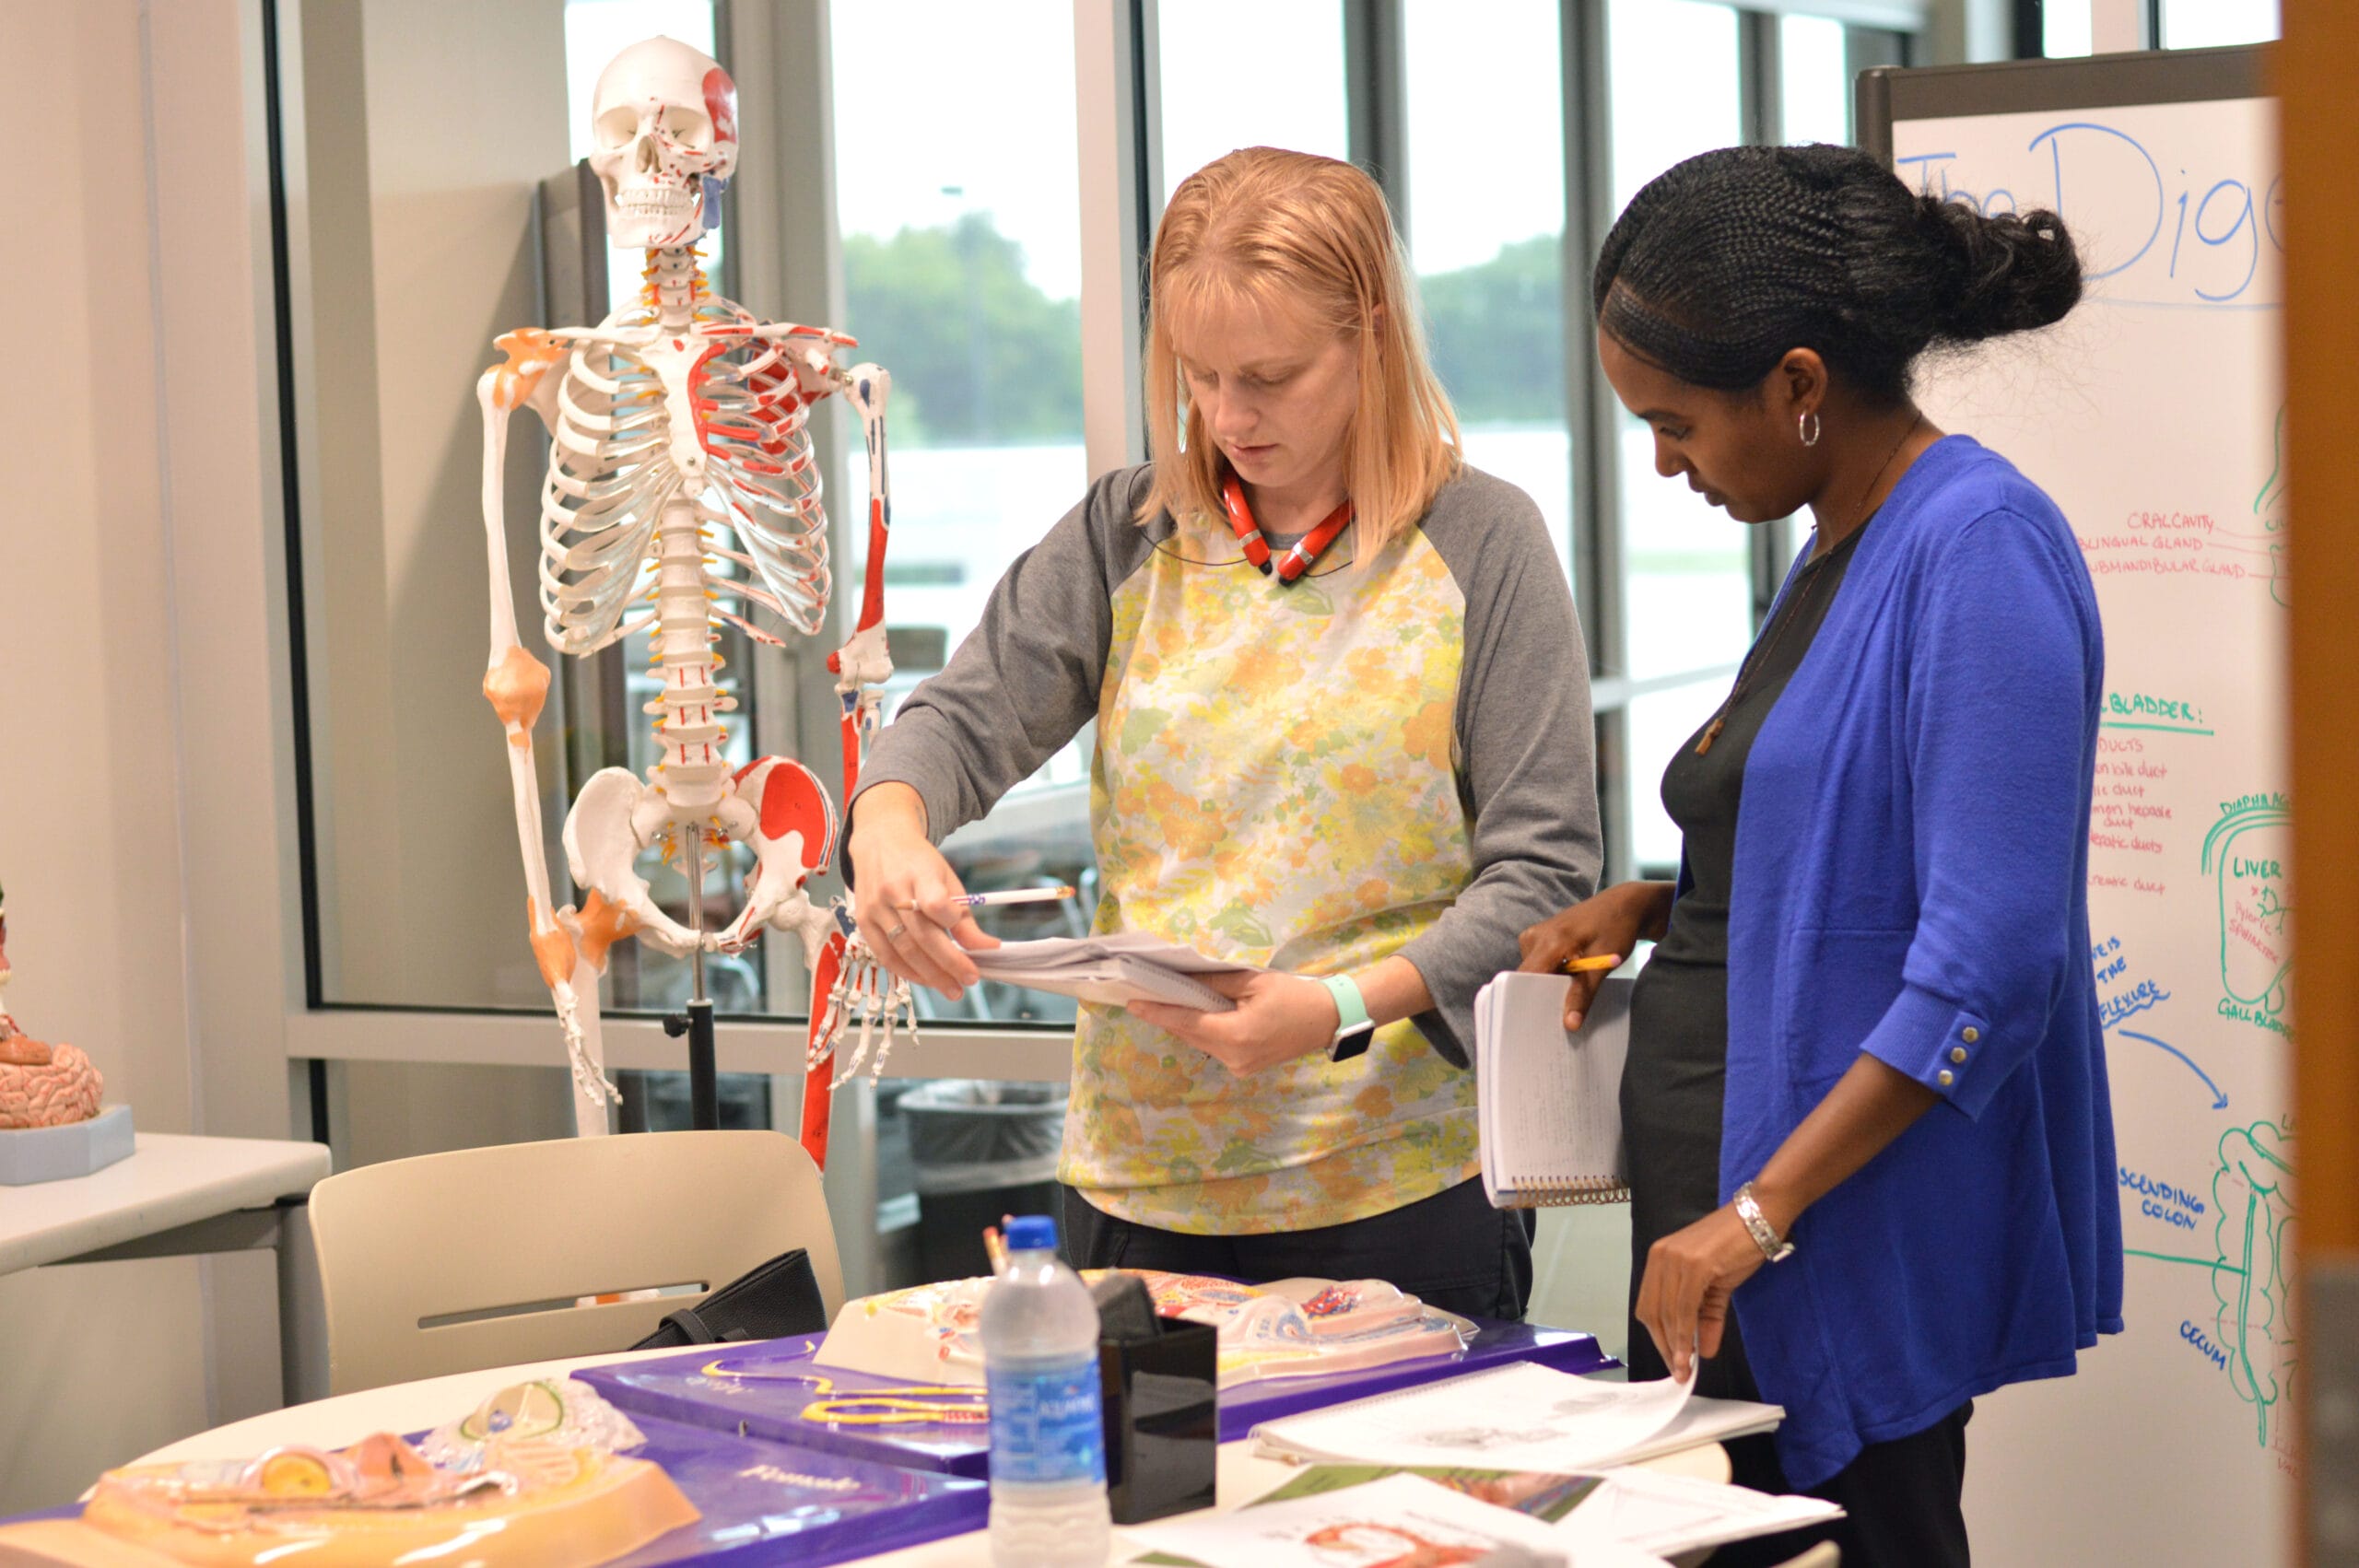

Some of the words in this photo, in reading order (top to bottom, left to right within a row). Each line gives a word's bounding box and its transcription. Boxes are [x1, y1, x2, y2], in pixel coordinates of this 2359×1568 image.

[2152, 535, 2203, 552] GLAND
[2201, 557, 2246, 579] GLAND
[2234, 856, 2283, 880] LIVER
[2142, 1199, 2197, 1231] COLON
[2180, 1320, 2226, 1371] CECUM
